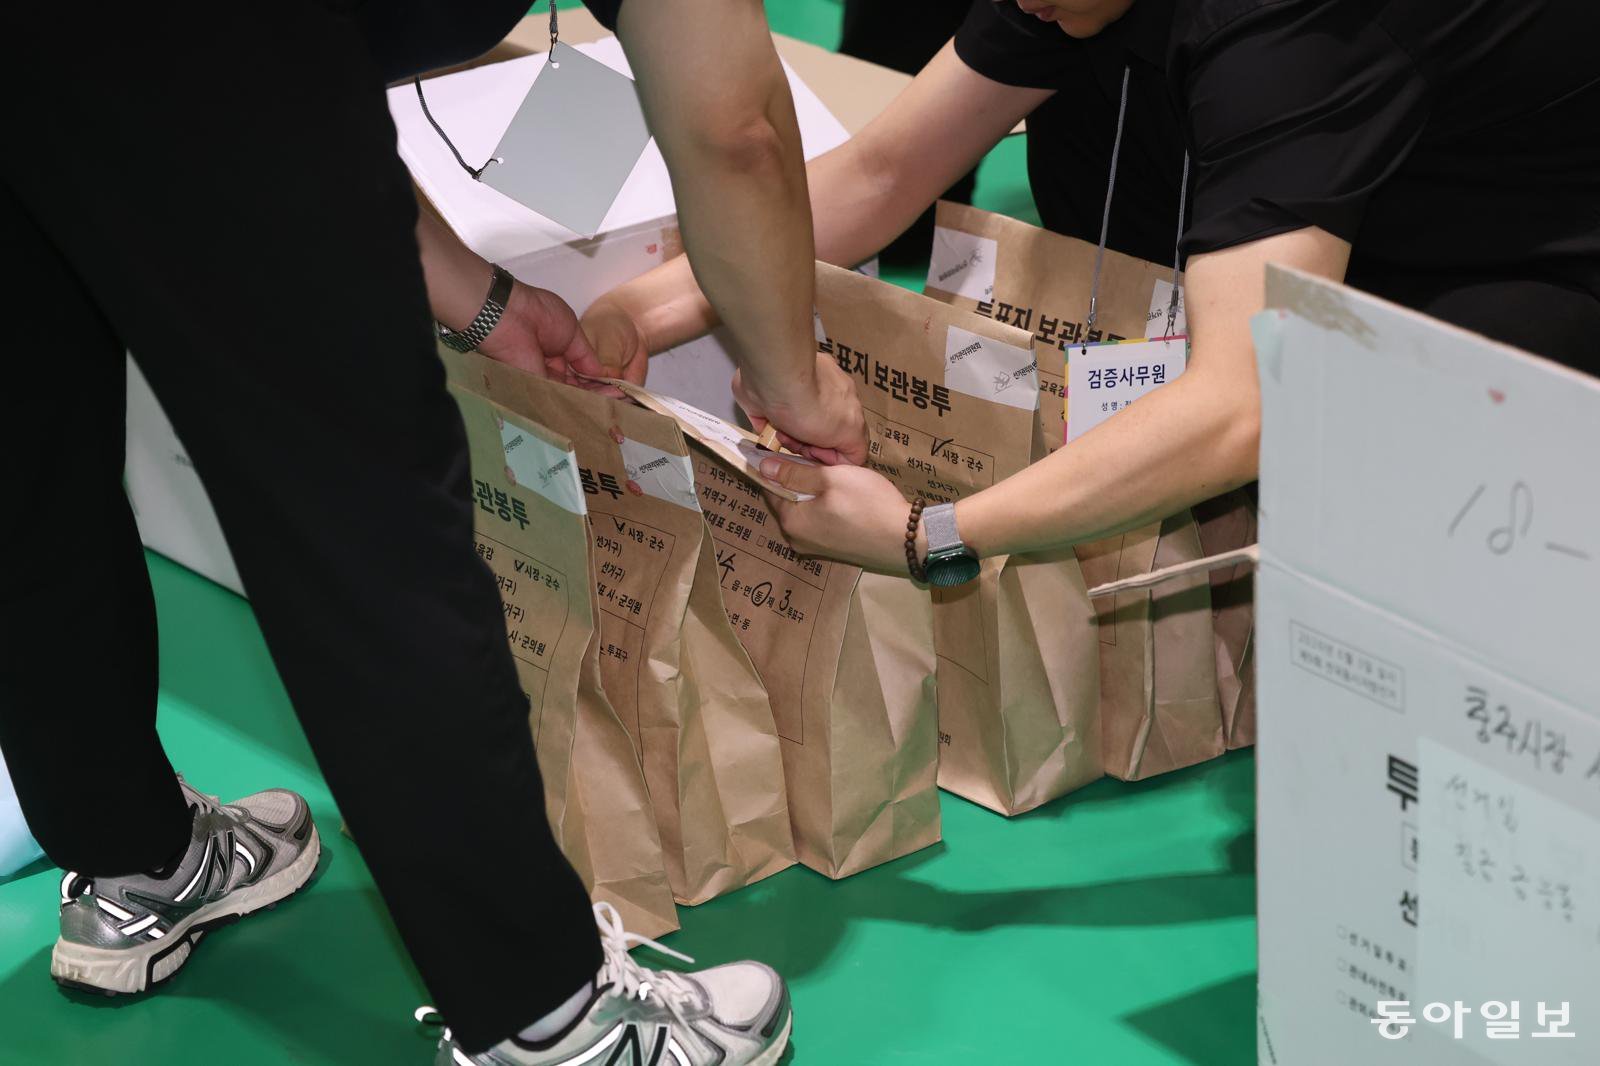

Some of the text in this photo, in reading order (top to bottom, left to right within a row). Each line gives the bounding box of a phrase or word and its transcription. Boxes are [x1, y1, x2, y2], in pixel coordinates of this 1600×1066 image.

[1087, 363, 1166, 390] 검증사무원
[873, 360, 952, 417] 보관봉투
[884, 427, 910, 447] 교육감
[907, 456, 937, 477] 선거구)
[942, 449, 984, 473] 시장·군수
[709, 466, 735, 486] 지역구
[473, 479, 530, 530] 관봉투
[702, 486, 728, 505] 지역구
[628, 527, 665, 551] 시장·군수
[726, 520, 752, 541] 도의원
[596, 535, 622, 558] 선거구)
[494, 573, 517, 595] 거구)
[524, 565, 561, 592] 시장·군수
[601, 561, 626, 584] 선거구)
[607, 586, 642, 615] 시·군의원
[779, 589, 792, 611] 3
[501, 601, 525, 623] 거구)
[508, 628, 546, 657] 시·군의원
[607, 642, 628, 662] 투표구
